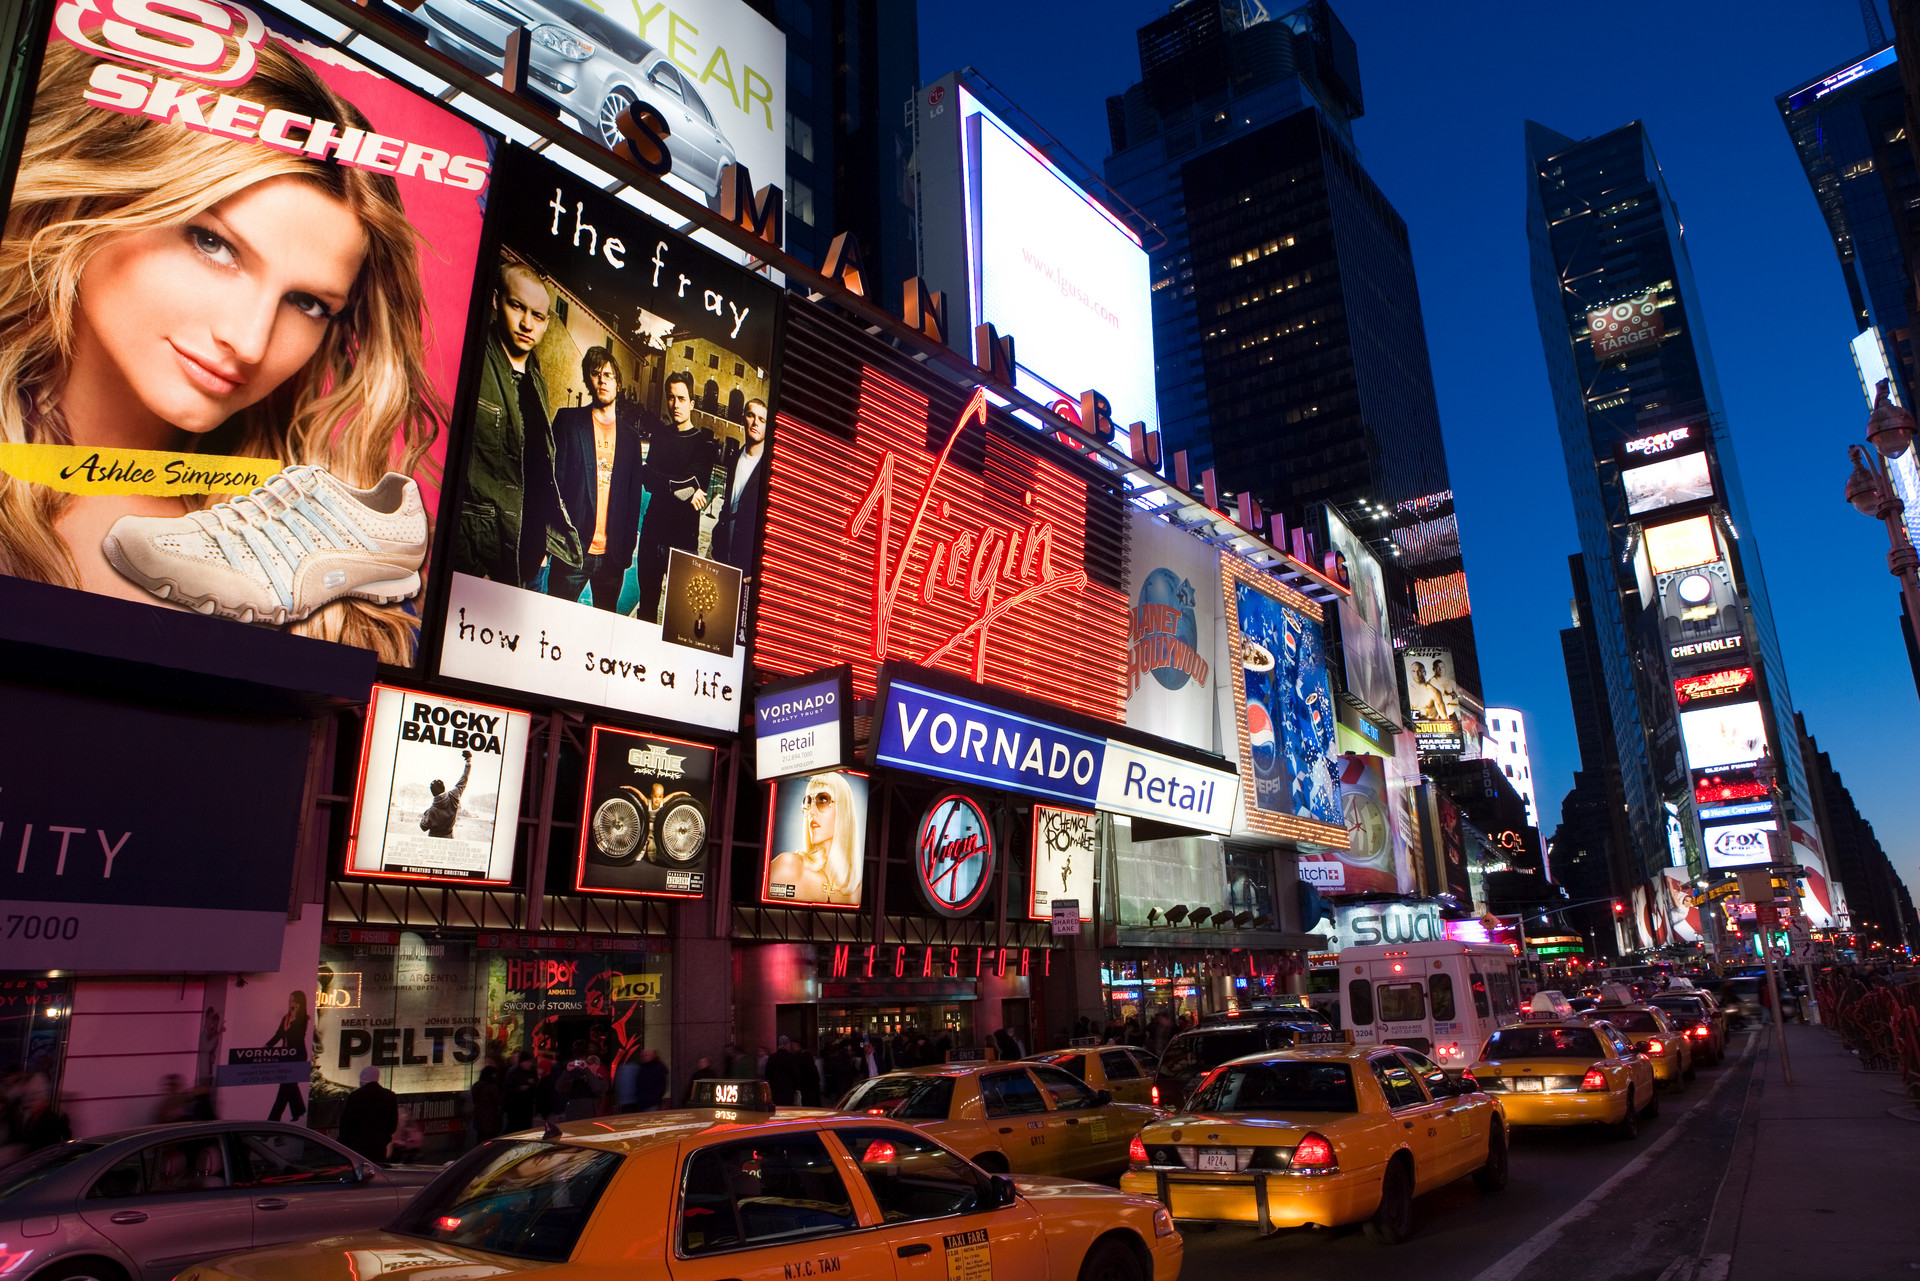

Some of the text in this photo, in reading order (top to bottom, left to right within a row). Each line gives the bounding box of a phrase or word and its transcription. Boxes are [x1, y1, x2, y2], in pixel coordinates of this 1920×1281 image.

[631, 0, 774, 132] YEAR
[930, 104, 944, 119] LG
[83, 64, 490, 191] SKECHERS
[550, 188, 749, 339] the fray
[1022, 247, 1119, 329] www.lgusa.com
[1600, 326, 1657, 351] TARGET
[1625, 427, 1690, 453] DISCOVER
[1643, 441, 1675, 455] CARD
[60, 453, 259, 489] Ashlee Simpson
[846, 386, 1087, 684] Virgin
[458, 607, 733, 701] how to save a life
[1671, 636, 1742, 658] CHEVROLET
[1126, 635, 1208, 702] HOLLYWOOD
[1690, 686, 1741, 699] SELECT
[412, 702, 500, 735] ROCKY
[760, 692, 835, 721] VORNADO
[772, 708, 823, 724] REALTY TRUST
[401, 720, 502, 755] BALBOA
[780, 731, 815, 753] Retail
[627, 748, 687, 773] GAME
[898, 702, 1215, 815] VORNADO Retail
[0, 822, 132, 879] ITY
[1725, 833, 1761, 847] FOX
[409, 867, 431, 875] THEATERS
[833, 944, 1051, 978] MEGASTORE
[547, 985, 577, 996] ANIMATED
[503, 1001, 537, 1012] SWORD
[547, 1000, 583, 1011] STORMS
[341, 1018, 395, 1027] MEAT LOAF
[424, 1016, 481, 1025] JOHN SAXON
[1355, 1029, 1373, 1038] 3204
[236, 1047, 297, 1058] VORNADO
[338, 1026, 481, 1069] PELTS
[715, 1084, 738, 1103] 9J25
[946, 1230, 986, 1248] TAXI FARE
[784, 1256, 840, 1280] N.Y.C. TAXI
